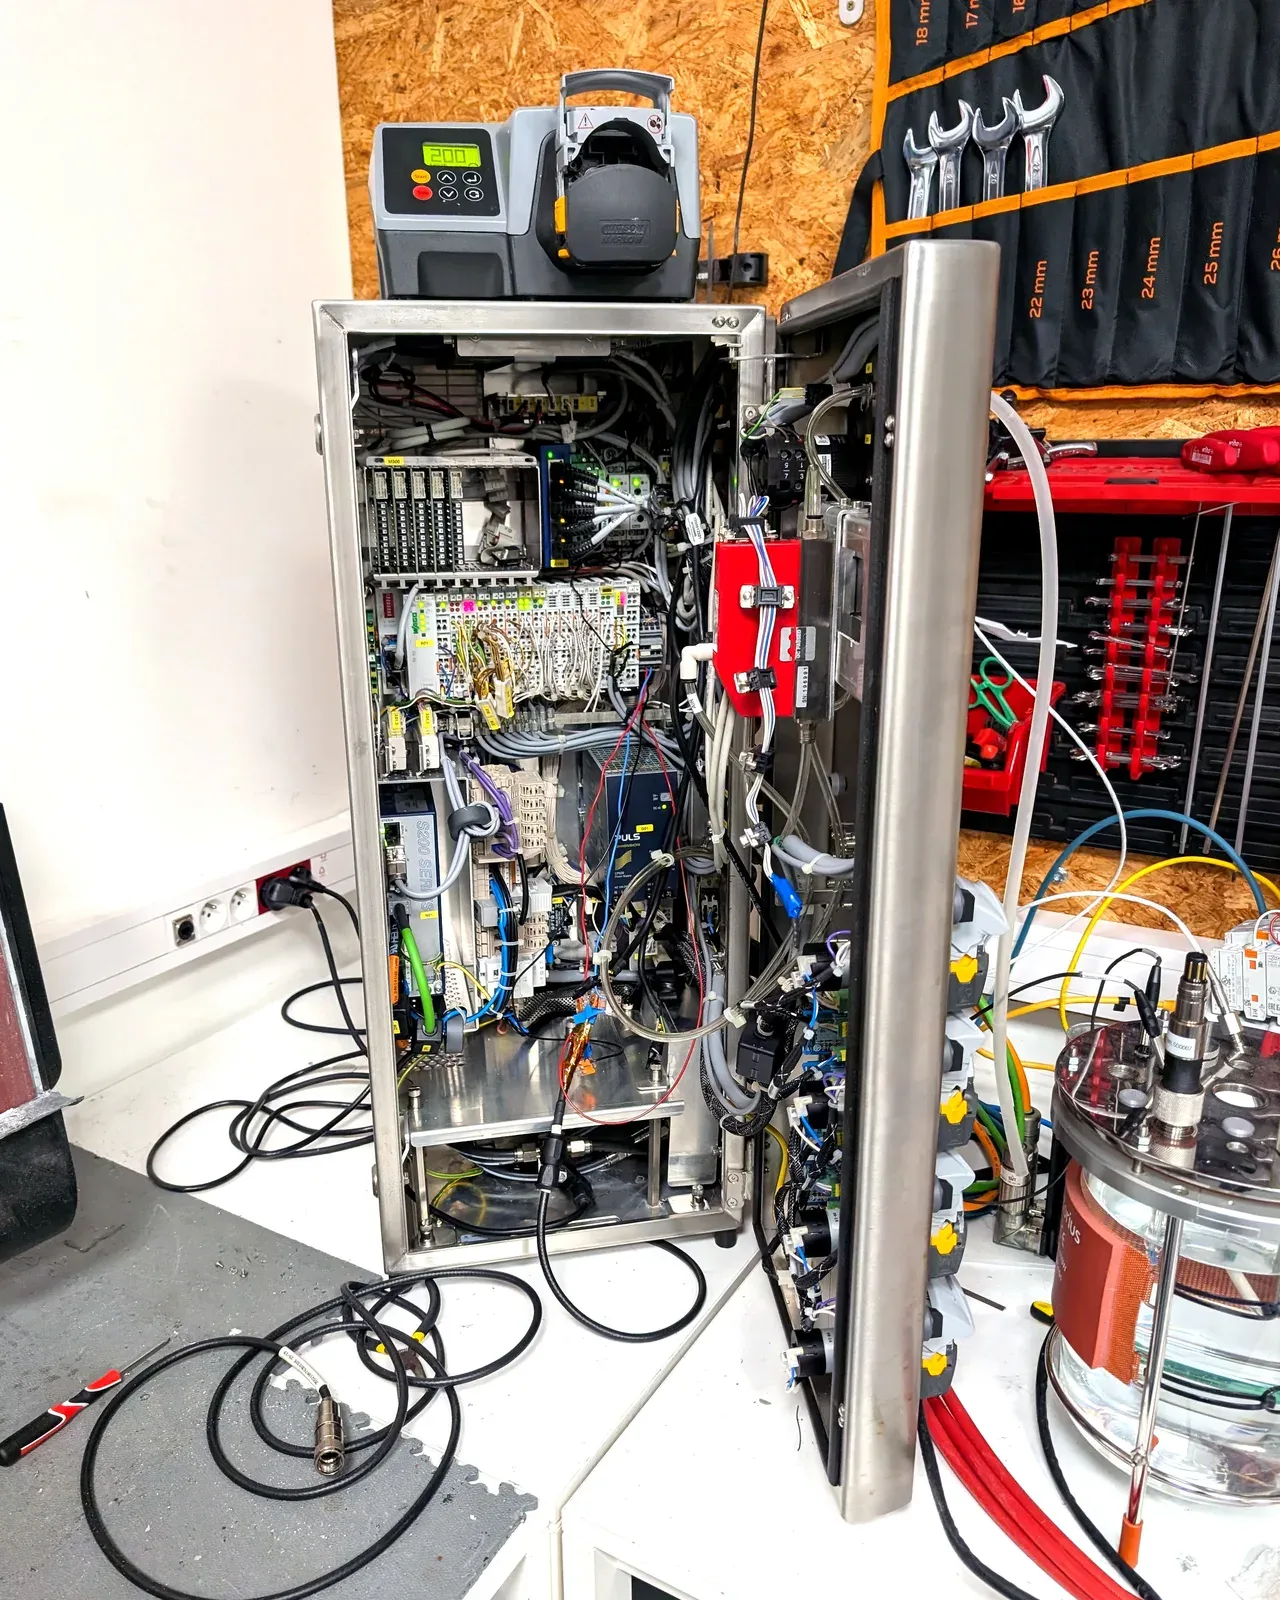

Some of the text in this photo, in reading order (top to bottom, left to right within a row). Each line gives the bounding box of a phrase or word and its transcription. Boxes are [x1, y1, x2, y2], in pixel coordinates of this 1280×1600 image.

[916, 27, 929, 46] 18
[965, 12, 979, 29] 17
[430, 148, 466, 163] 200
[1081, 250, 1100, 310] 23 mm
[1141, 237, 1161, 299] 24 mm
[1203, 222, 1224, 285] 25 mm
[1029, 260, 1048, 318] 22 mm
[411, 611, 420, 635] WAGO
[416, 820, 435, 911] S200 SERIS
